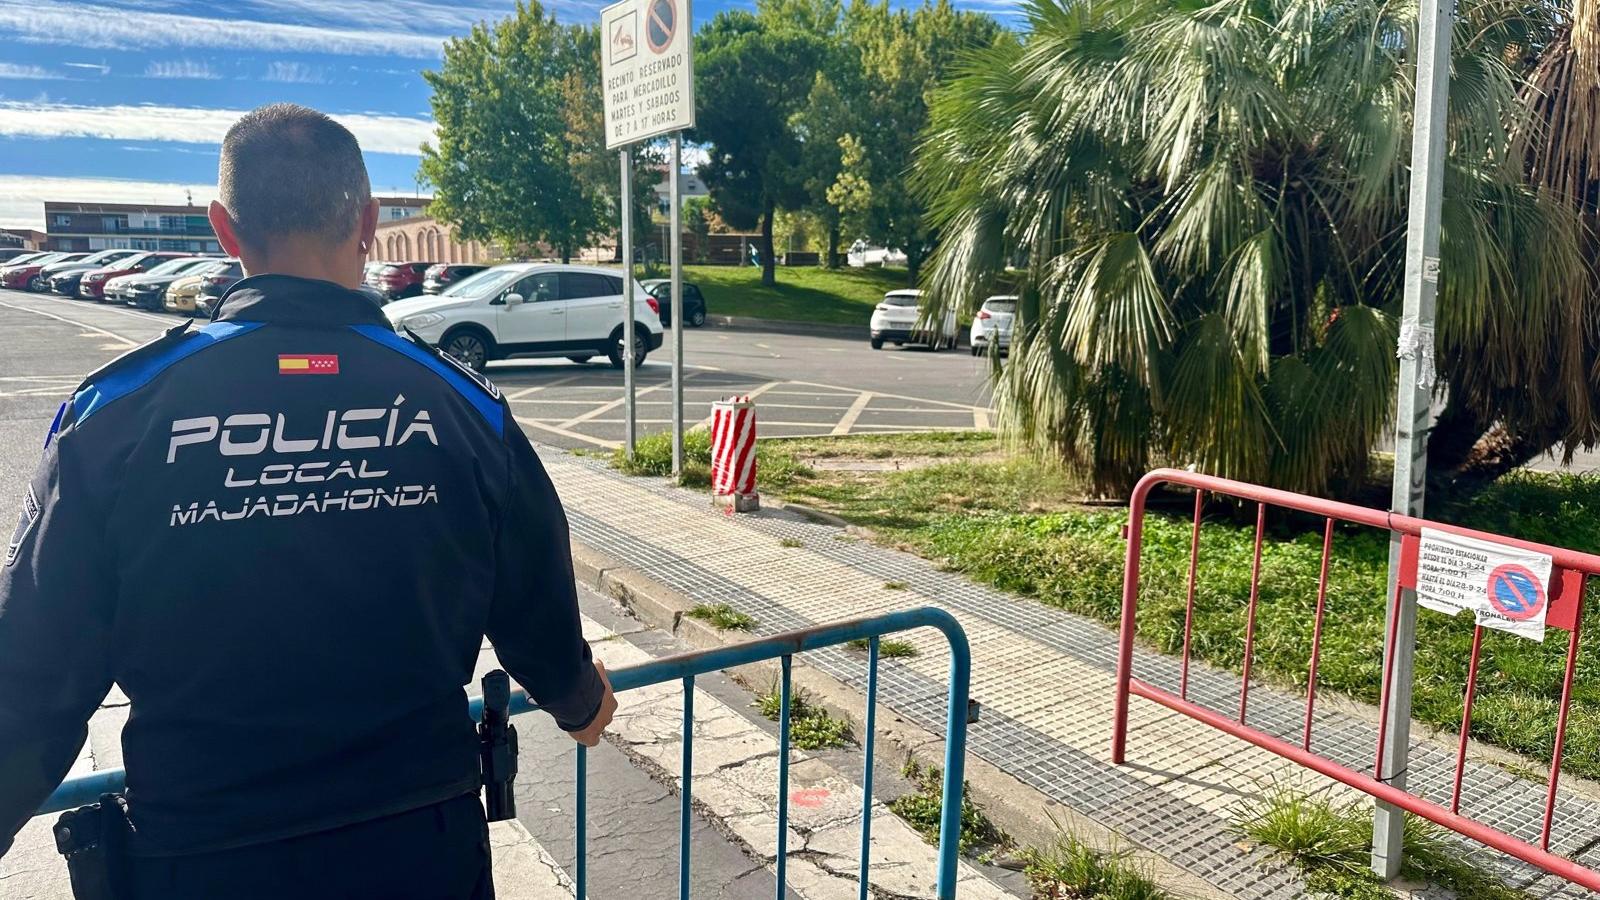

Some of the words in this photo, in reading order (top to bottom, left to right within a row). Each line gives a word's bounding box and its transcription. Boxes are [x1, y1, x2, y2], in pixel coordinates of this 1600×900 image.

[608, 71, 633, 91] RECINTO
[639, 53, 682, 78] RESERVADO
[613, 90, 628, 105] PARA
[633, 73, 677, 98] MERCADILLO
[611, 104, 635, 121] MARTES
[647, 90, 680, 111] SABADOS
[615, 124, 623, 137] DE
[642, 117, 647, 128] 17
[652, 109, 676, 126] HORAS
[166, 393, 439, 464] POLICÍA
[224, 459, 389, 488] LOCAL
[169, 484, 439, 527] MAJADAHONDA
[1423, 553, 1440, 563] DESDE
[1441, 556, 1447, 564] EL
[1458, 560, 1485, 571] 3-9-24
[1424, 543, 1454, 555] PROHIBIDO
[1455, 549, 1488, 563] ESTACIONAR
[1421, 583, 1436, 592] HORA
[1458, 592, 1465, 600] H
[1422, 573, 1438, 583] HASTA
[1439, 577, 1446, 585] EL
